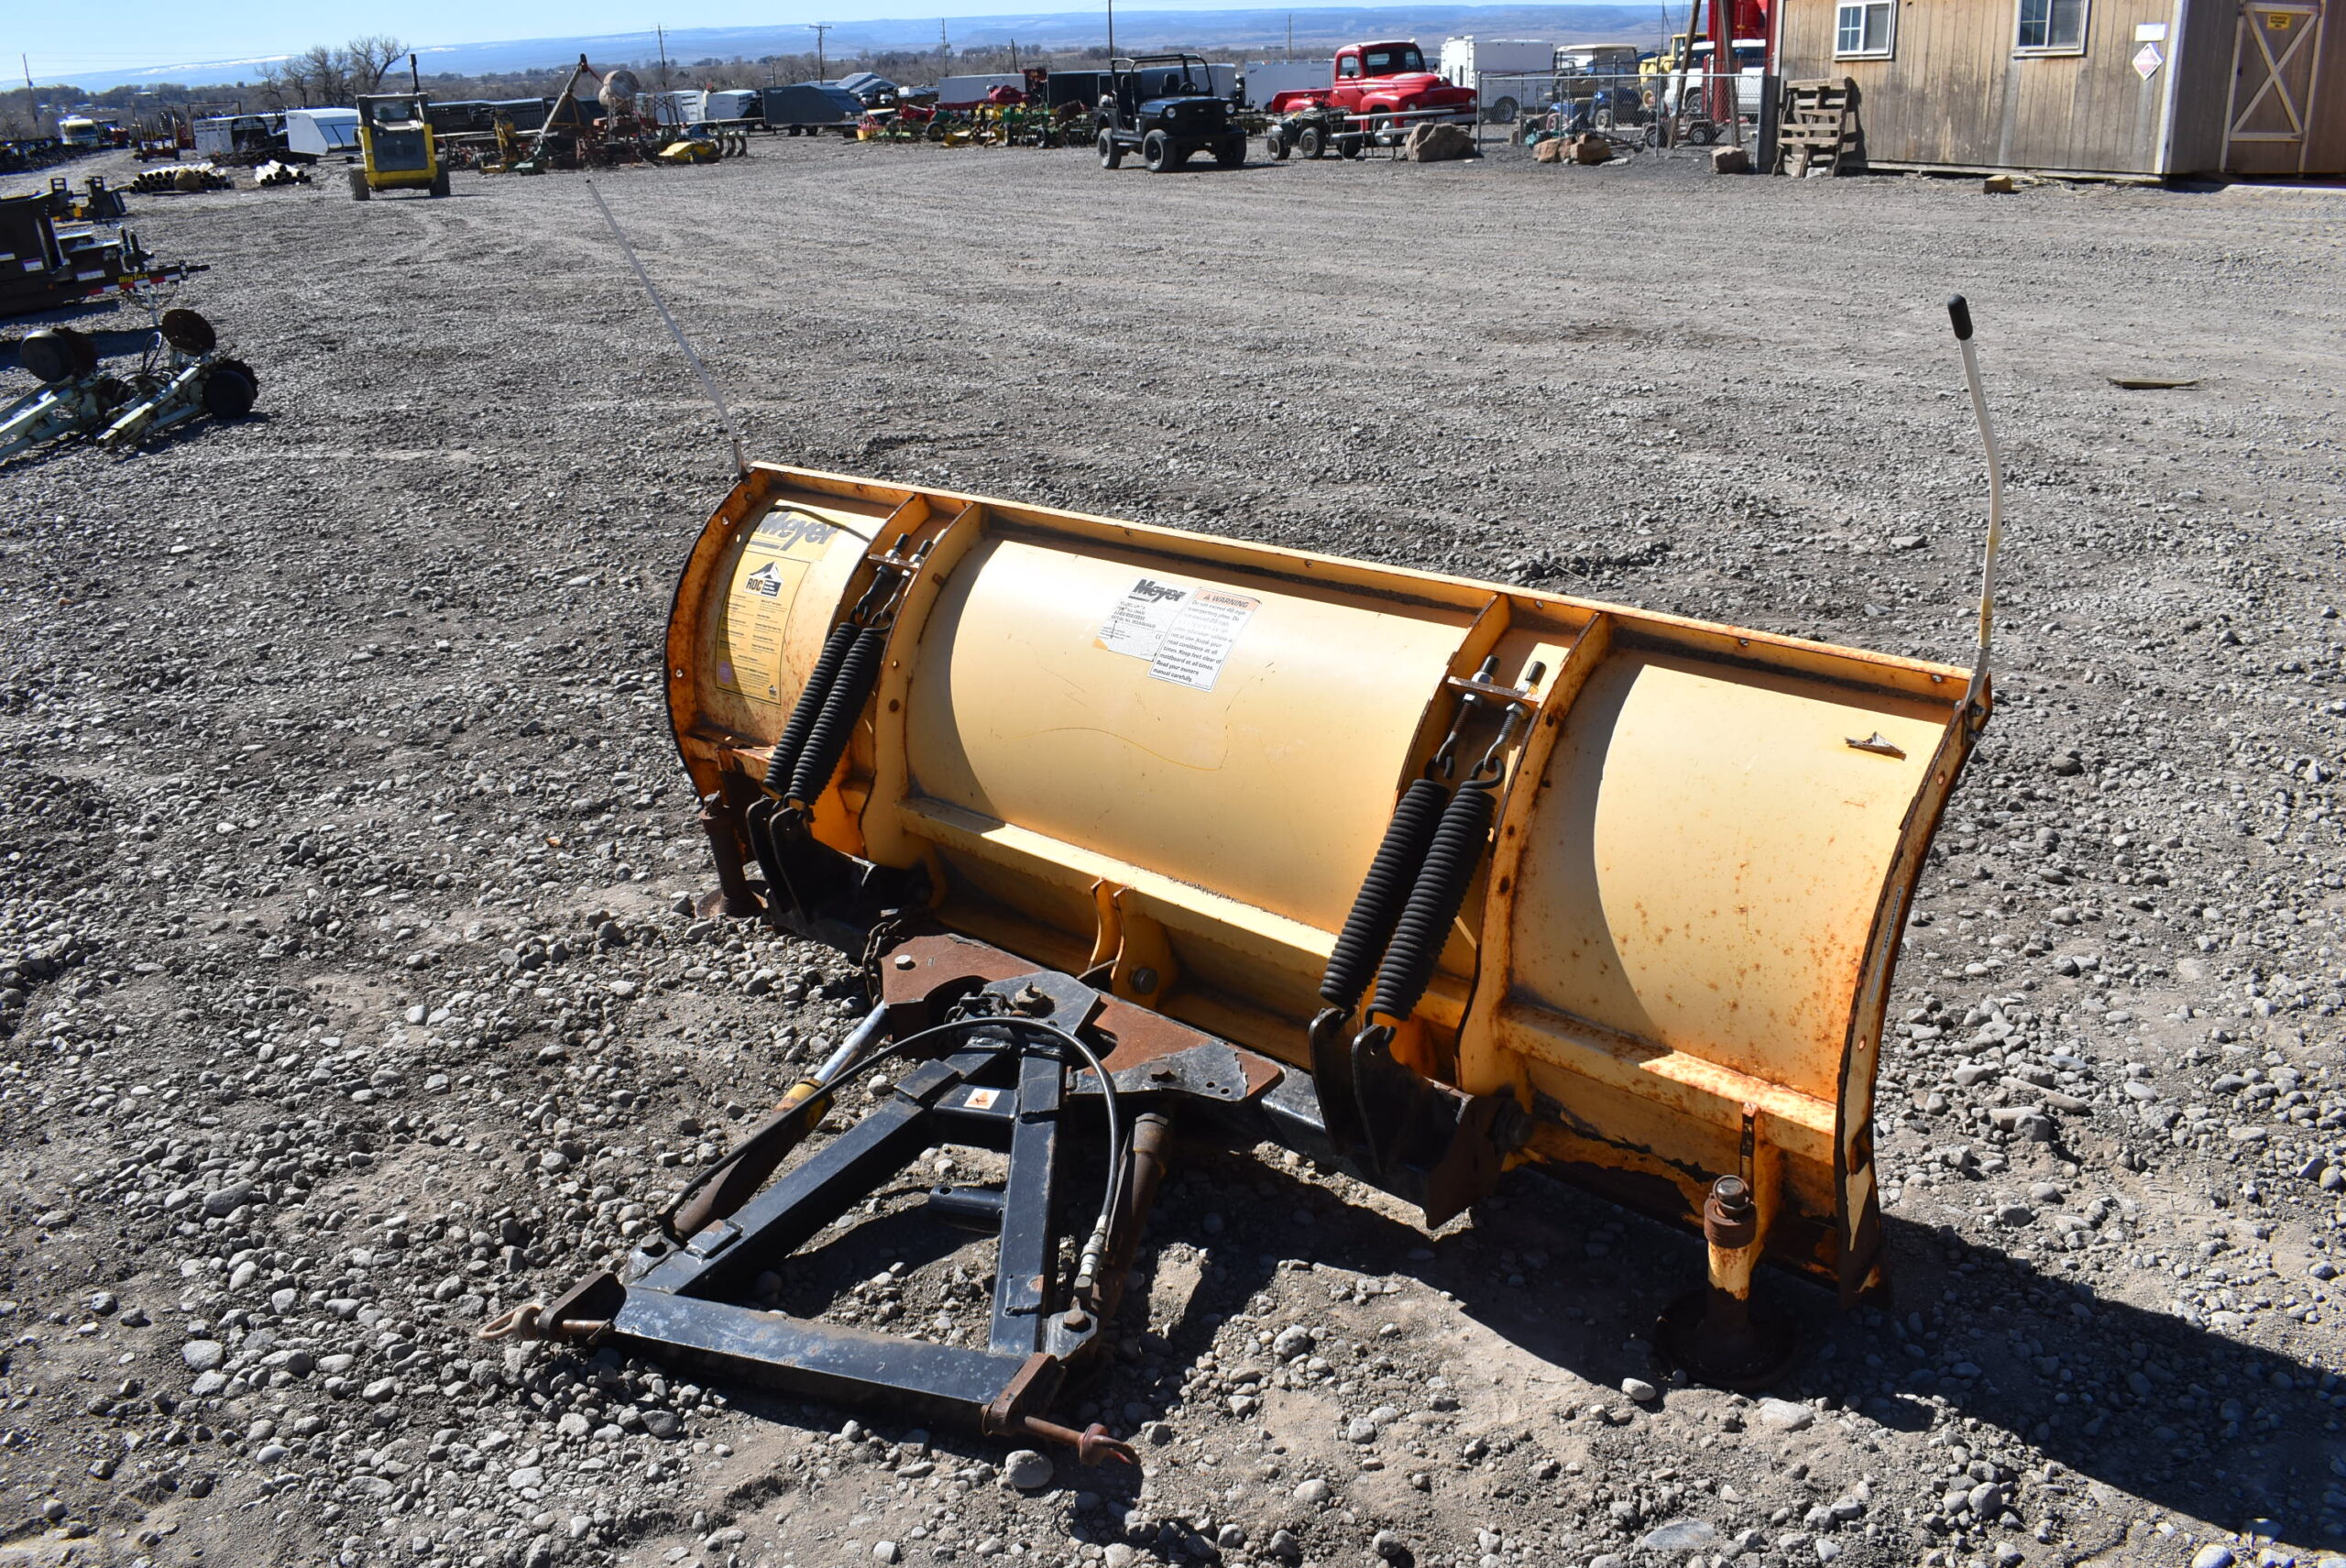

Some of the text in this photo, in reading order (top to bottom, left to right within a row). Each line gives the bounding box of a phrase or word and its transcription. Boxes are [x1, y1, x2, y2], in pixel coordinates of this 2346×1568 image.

[754, 511, 839, 552] Meyer
[746, 578, 763, 591] ROC
[1132, 578, 1187, 604] Meyer
[1211, 595, 1250, 609] WARNING
[1178, 642, 1203, 652] conditions
[1178, 649, 1191, 657] Keep
[1158, 653, 1186, 663] moldboard
[1198, 663, 1213, 671] times.
[1152, 667, 1193, 683] manual carefully.
[1180, 667, 1200, 675] owners
